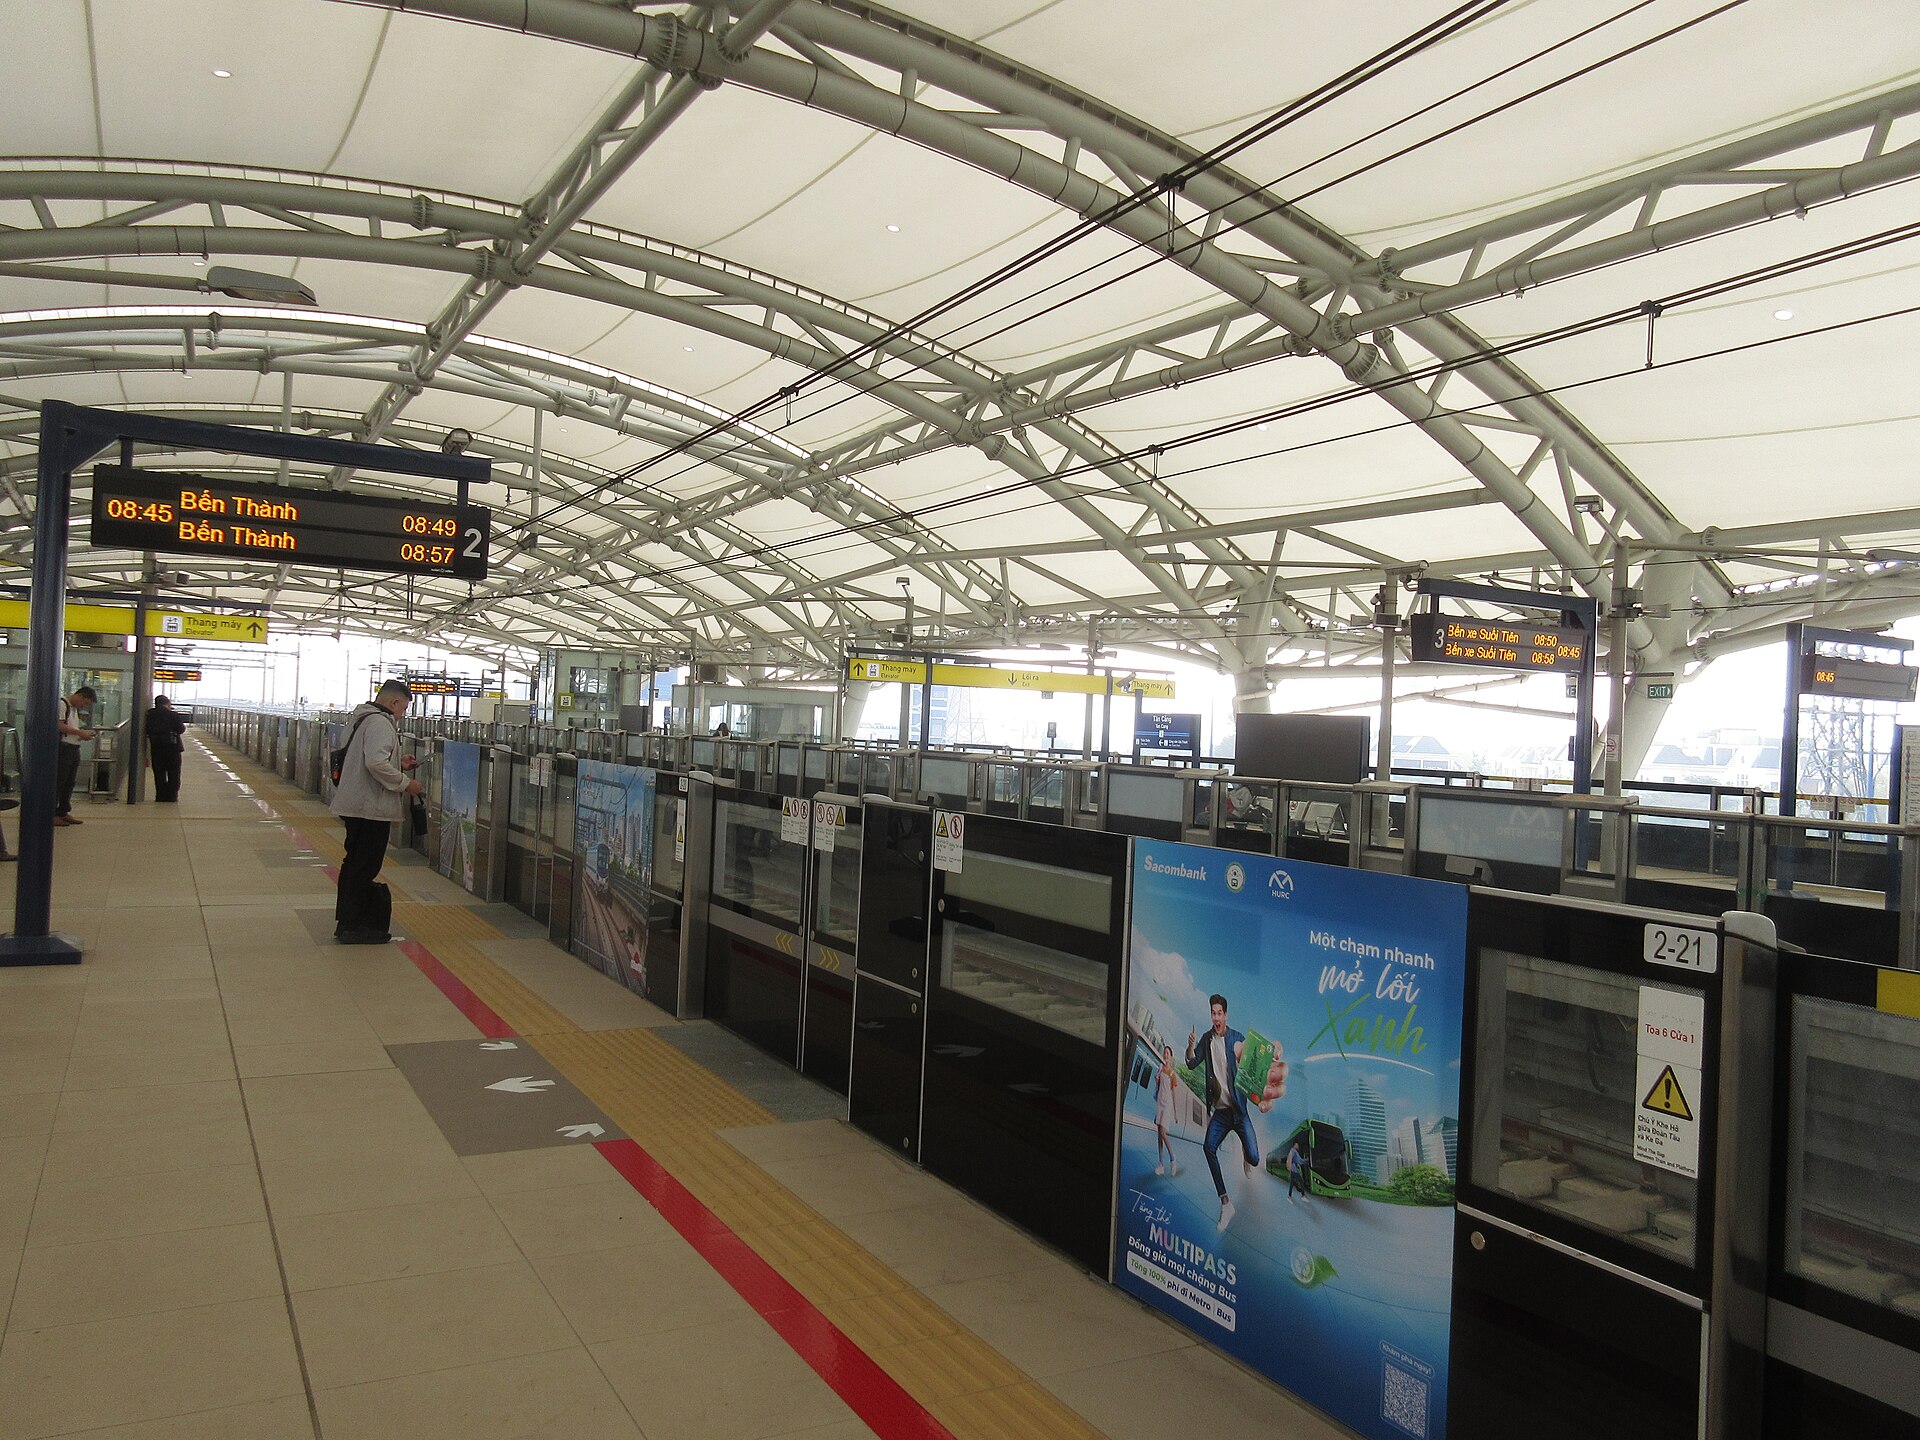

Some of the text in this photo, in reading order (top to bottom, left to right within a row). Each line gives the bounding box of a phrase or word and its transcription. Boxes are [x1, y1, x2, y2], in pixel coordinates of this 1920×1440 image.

[107, 499, 174, 523] 08:45
[180, 489, 298, 521] Bến Thành
[179, 519, 296, 550] Bến Thành
[402, 515, 457, 537] 08:49
[400, 543, 455, 564] 08:57
[462, 528, 483, 558] 2
[185, 627, 215, 636] Elevator
[186, 616, 242, 631] Thang máy
[1447, 623, 1520, 644] Bến xe Suối Tiên
[1434, 628, 1445, 649] 3
[1534, 634, 1558, 648] 08:50
[1445, 642, 1517, 662] Bến xe Suối Tiên
[1531, 652, 1556, 665] 08:58
[1557, 645, 1581, 659] 08:45
[881, 663, 917, 675] Thang máy
[1816, 671, 1835, 683] 08:45
[1133, 680, 1151, 690] Thang
[1649, 684, 1667, 697] EXIT
[1143, 855, 1207, 881] Sacombank
[1271, 889, 1290, 900] HURC
[1310, 930, 1435, 970] Một chạm nhanh
[1653, 930, 1701, 967] 2-21
[1318, 960, 1420, 1003] mở lối
[1307, 992, 1428, 1062] Xanh
[1645, 1023, 1695, 1044] Toa 6 Cửa 1
[1149, 1222, 1237, 1286] MULTIPASS
[1128, 1235, 1151, 1257] Đồng
[1152, 1248, 1167, 1264] giá
[1168, 1258, 1186, 1275] mọi
[1218, 1284, 1237, 1304] Bus
[1149, 1267, 1167, 1285] 100%
[1188, 1291, 1212, 1311] Metro
[1216, 1307, 1232, 1323] Bus
